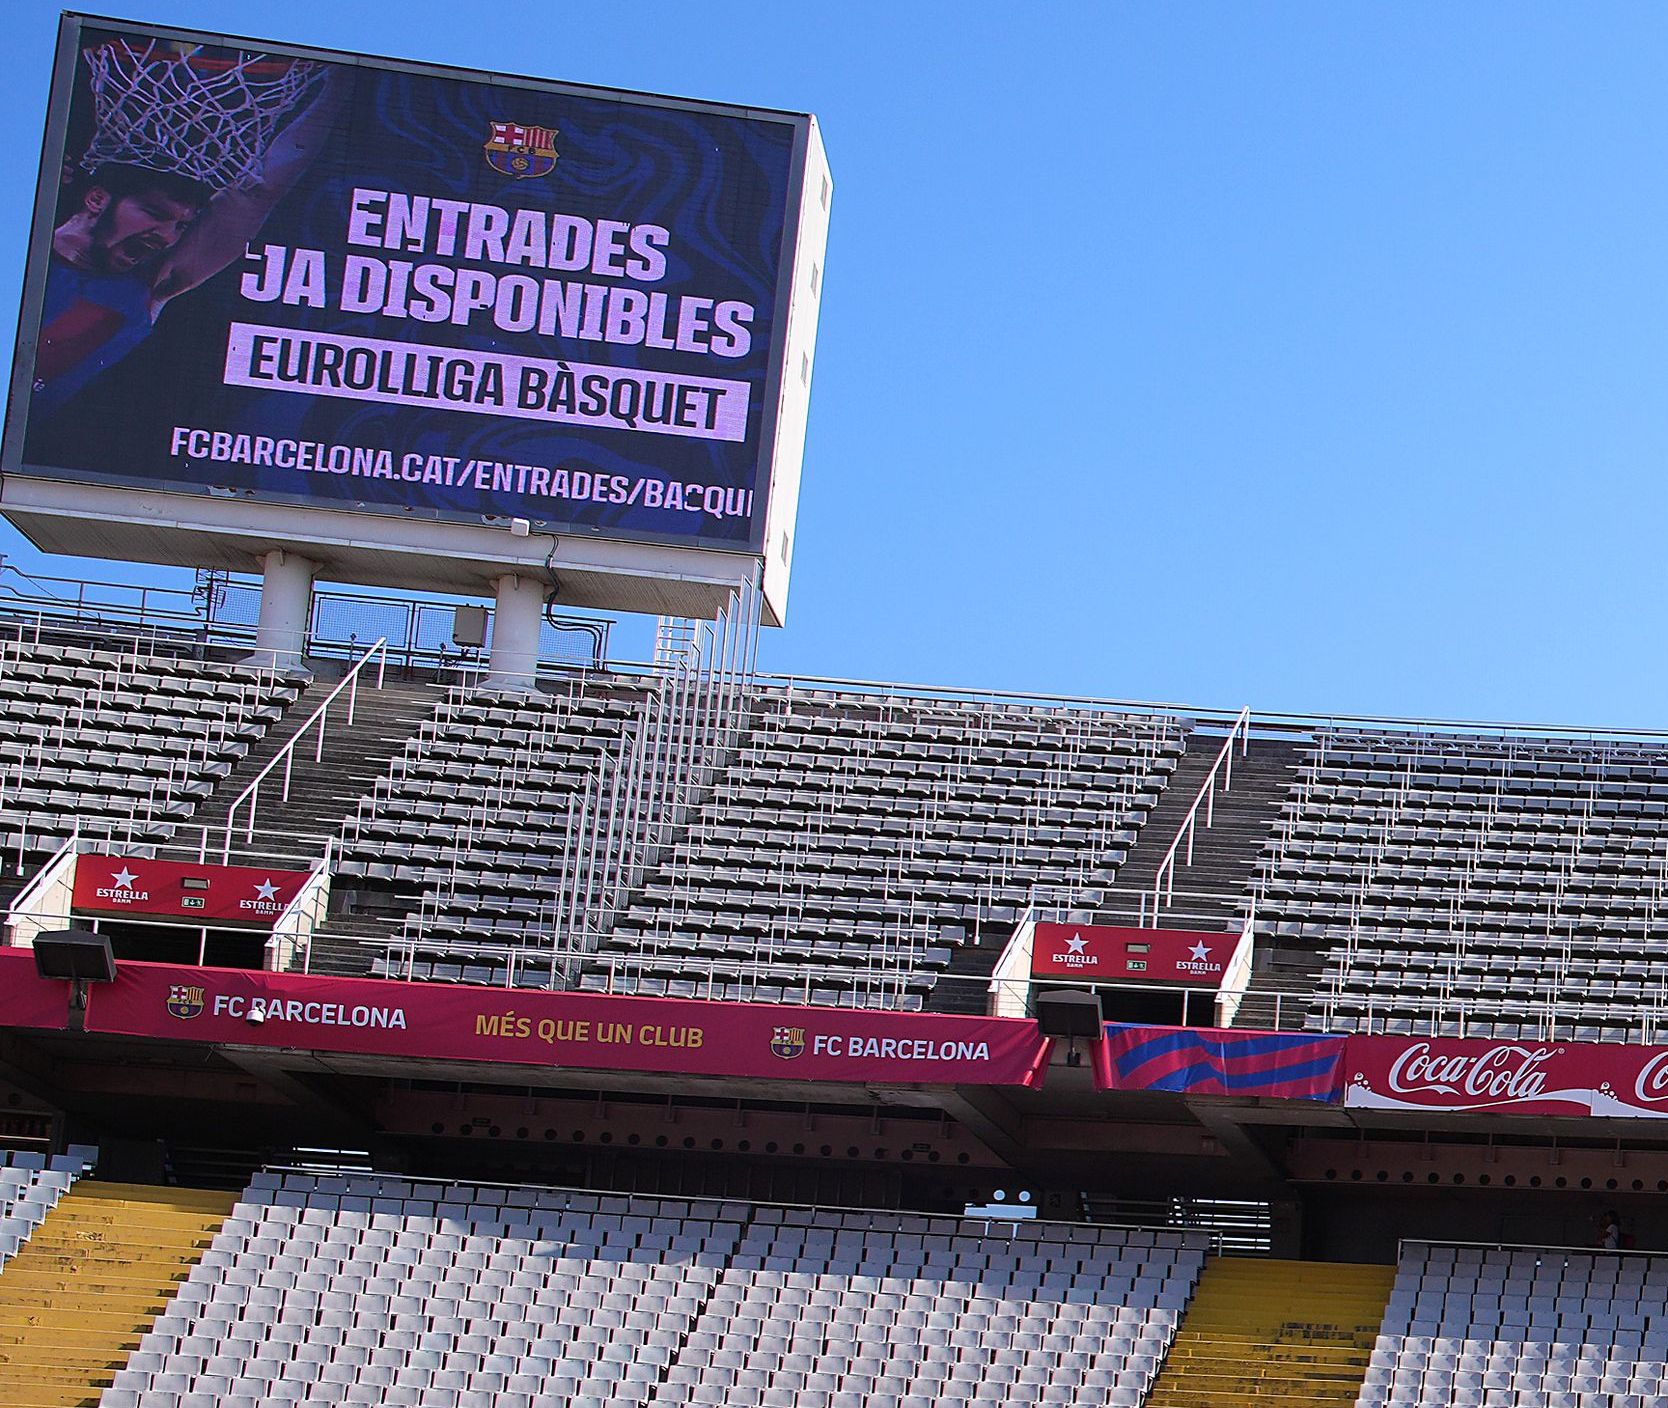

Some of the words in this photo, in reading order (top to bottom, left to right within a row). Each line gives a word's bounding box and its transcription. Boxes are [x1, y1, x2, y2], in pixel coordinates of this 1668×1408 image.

[347, 187, 670, 281] ENTRADES
[240, 243, 326, 308] JA
[340, 254, 755, 358] DISPONIBLES
[248, 335, 503, 406] EUROLLIGA
[516, 362, 727, 430] BÀSQUET
[96, 888, 148, 901] ESTRELLA
[1052, 954, 1098, 964] ESTRELLA
[1176, 961, 1221, 971] ESTRELLA
[213, 995, 245, 1018] FC
[475, 1010, 532, 1038] MÉS
[538, 1018, 590, 1044] QUE
[597, 1022, 633, 1044] UN
[639, 1025, 704, 1048] CLUB
[813, 1035, 842, 1057] FC
[848, 1037, 990, 1060] BARCELONA
[1388, 1042, 1557, 1097] Coca-Cola
